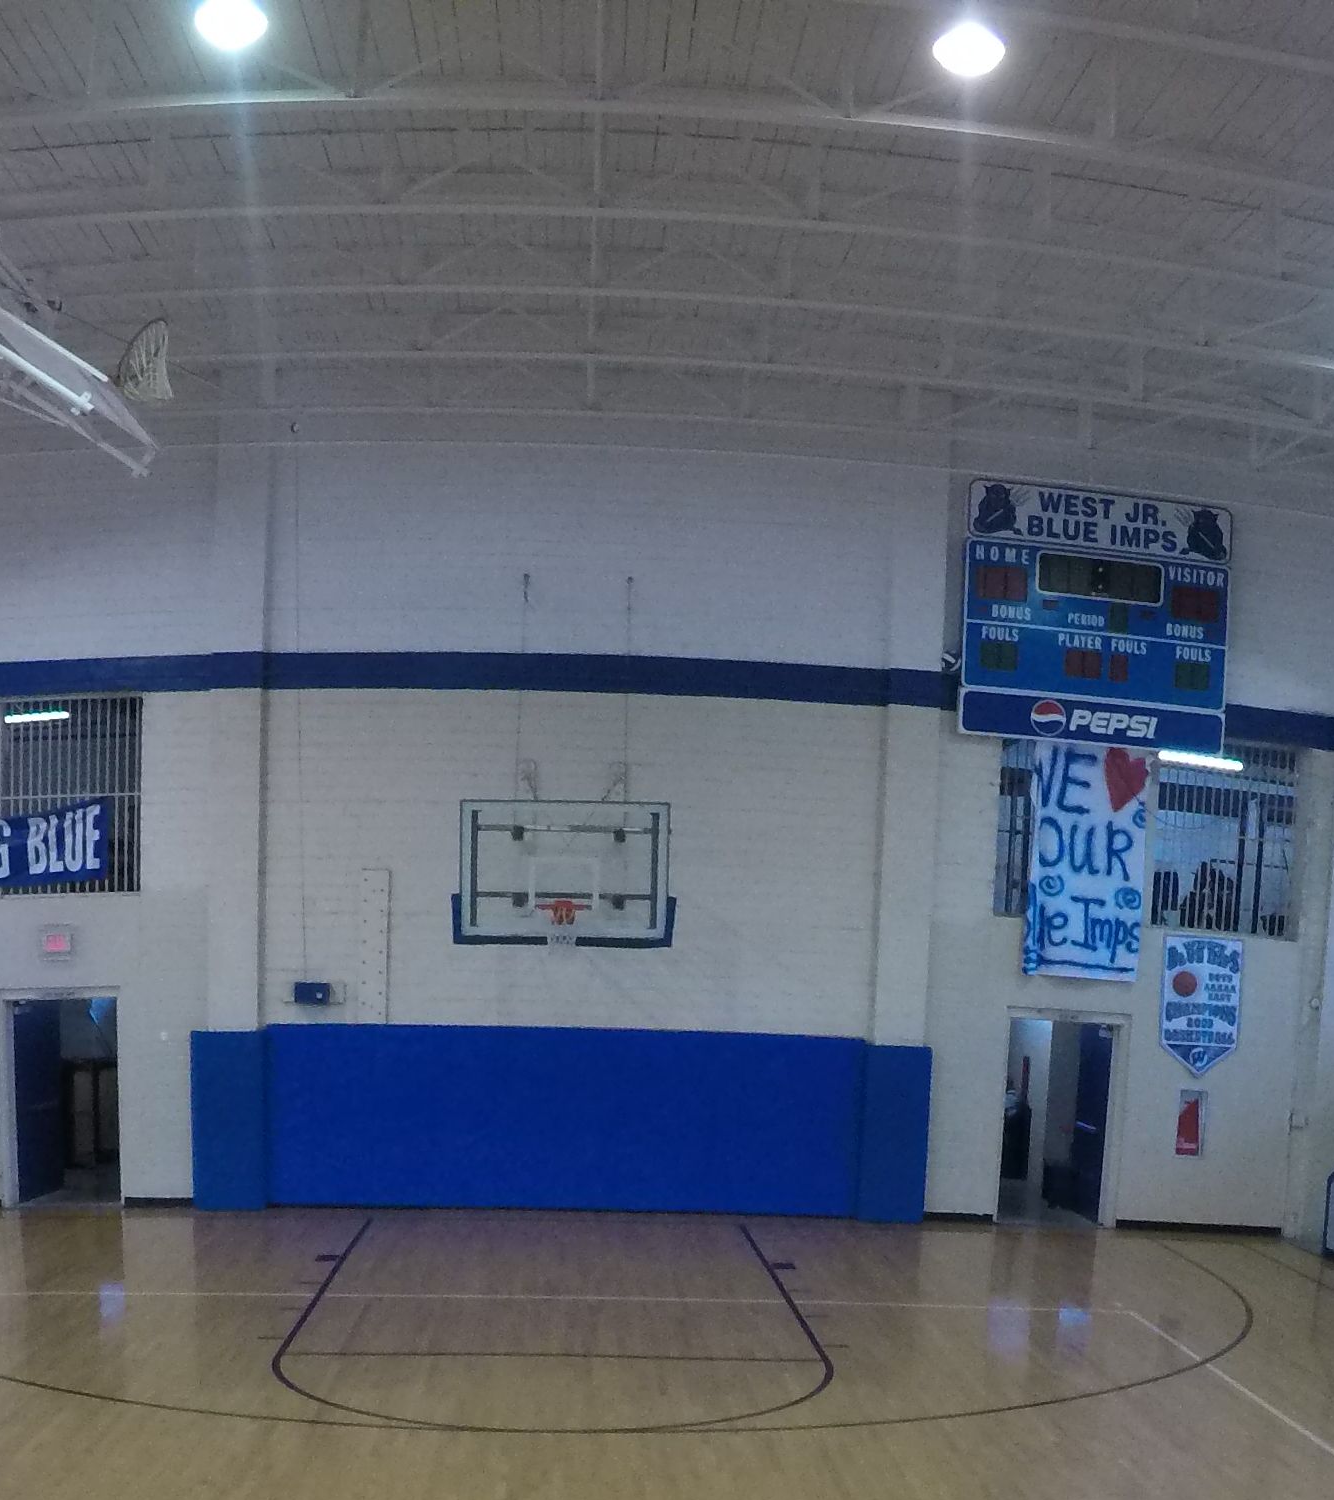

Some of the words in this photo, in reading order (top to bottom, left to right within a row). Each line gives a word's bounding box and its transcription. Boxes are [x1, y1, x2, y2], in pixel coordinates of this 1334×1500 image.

[1038, 491, 1115, 519] WEST
[1125, 502, 1166, 526] JR.
[1027, 515, 1099, 543] BLUE
[1110, 524, 1178, 552] IMPS
[975, 544, 1030, 565] HOME
[1168, 565, 1225, 588] VISITOR
[991, 604, 1032, 622] BONUS
[1067, 612, 1105, 627] PERIOD
[981, 625, 1019, 642] FOULS
[1166, 622, 1204, 639] BONUS
[1058, 632, 1102, 650] PLAYER
[1110, 638, 1147, 655] FOULS
[1175, 646, 1212, 662] FOULS
[1069, 709, 1158, 739] PEPSI
[27, 804, 100, 875] BLUE
[1038, 816, 1134, 881] OUR
